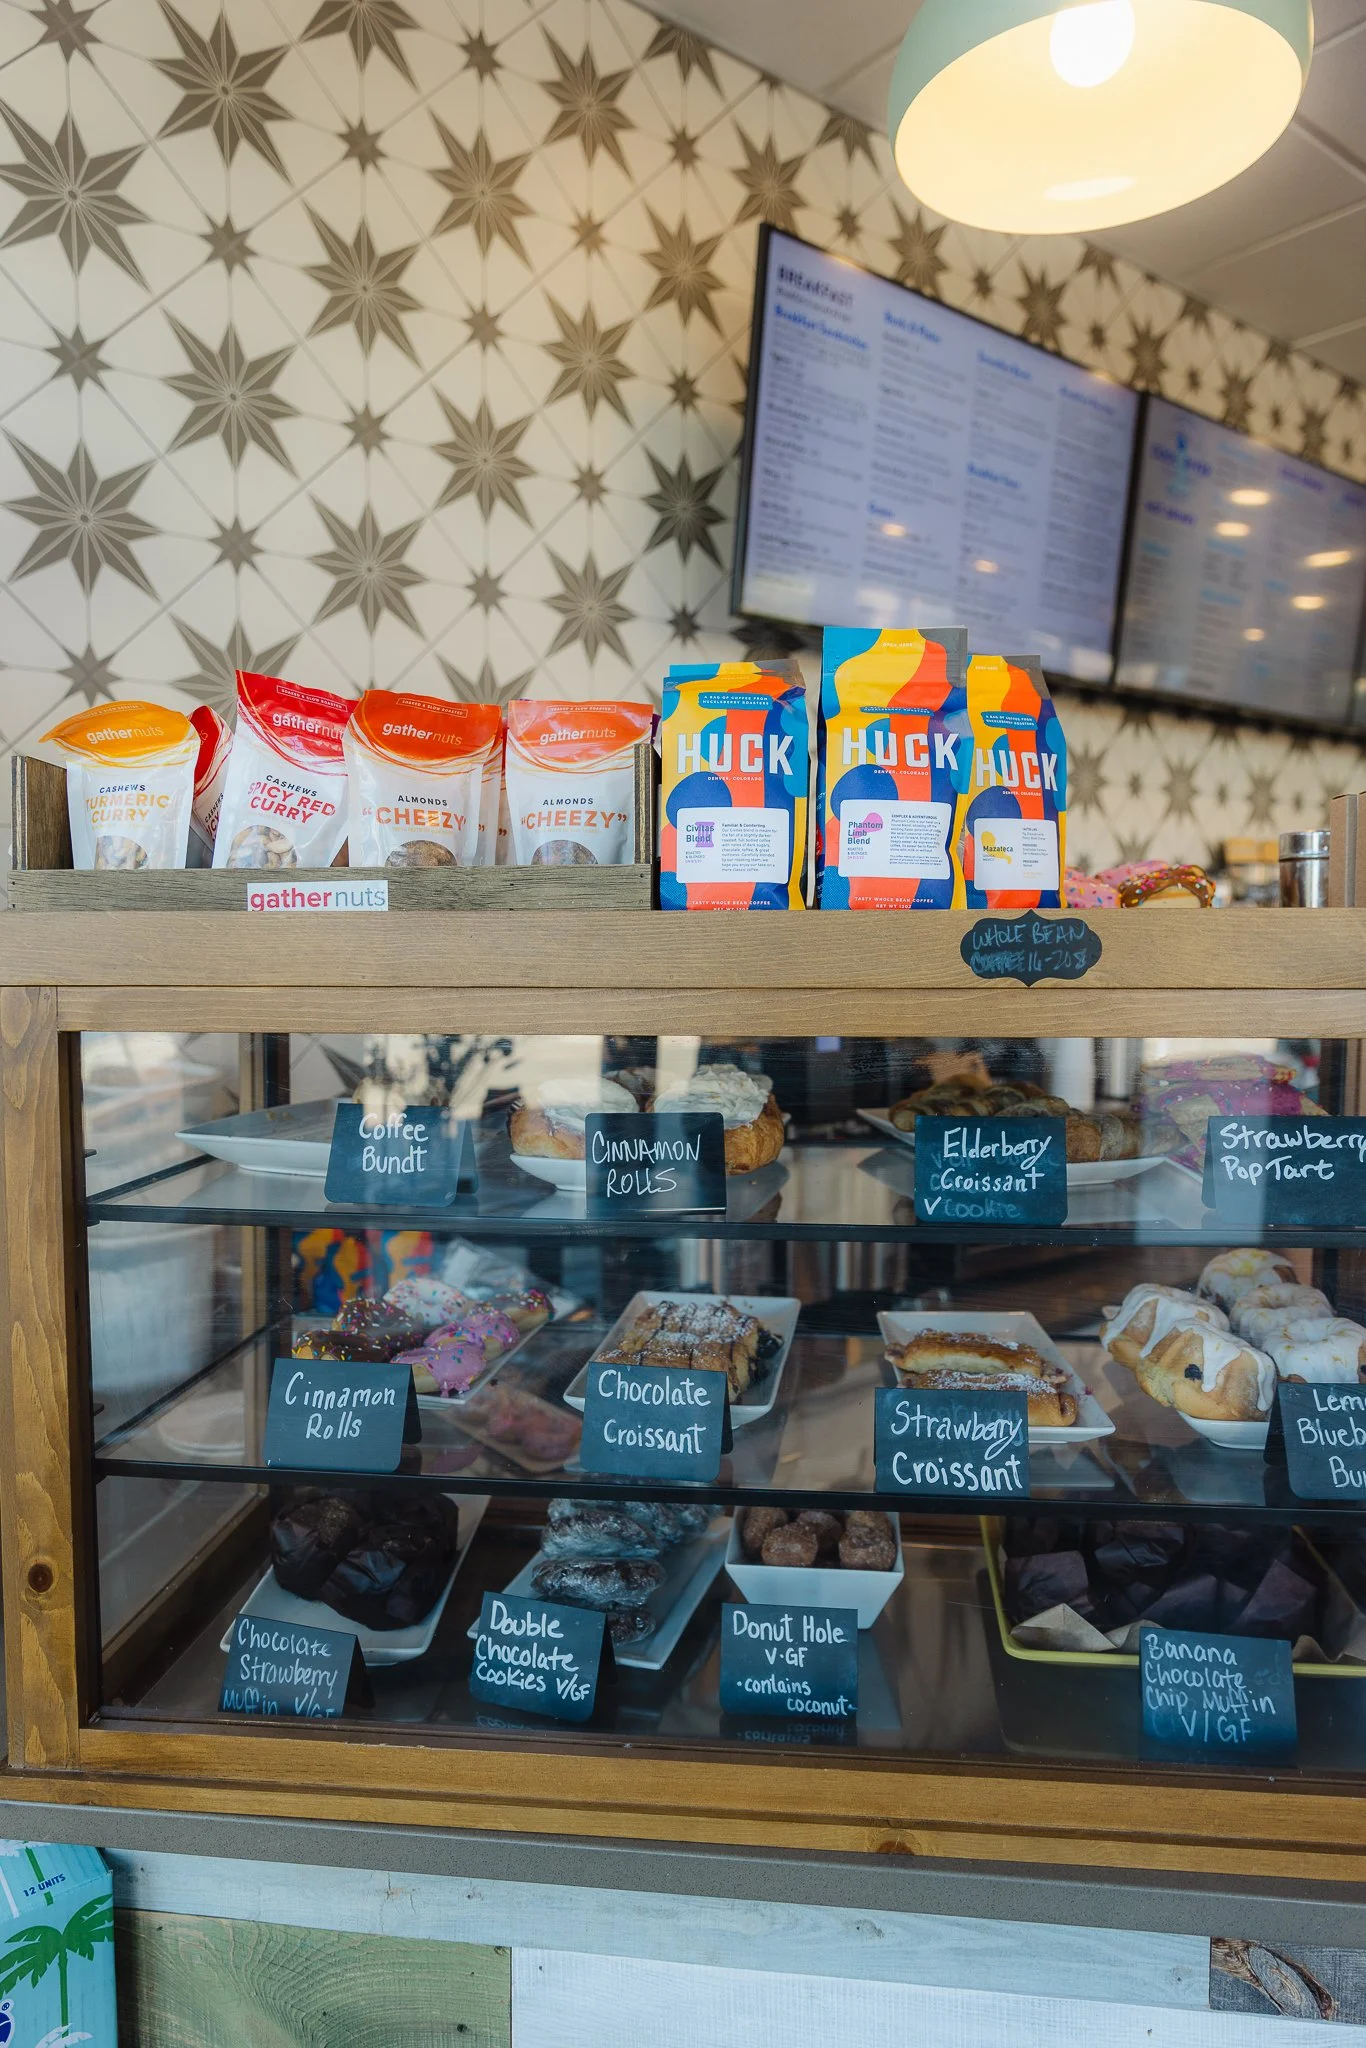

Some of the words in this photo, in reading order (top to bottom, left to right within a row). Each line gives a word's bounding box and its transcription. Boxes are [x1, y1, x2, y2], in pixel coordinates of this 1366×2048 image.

[677, 733, 794, 776] HUCK
[842, 727, 959, 771] HUCK
[975, 747, 1058, 792] HUCK
[99, 784, 146, 794] CASHEWS
[247, 781, 294, 802] SPICY
[297, 795, 336, 817] RED
[266, 774, 318, 797] CASHEWS
[91, 807, 150, 825] CURRY
[250, 796, 314, 824] CURRY
[398, 795, 448, 807] ALMONDS
[542, 797, 594, 806] ALMONDS
[685, 824, 715, 833] Civitas
[685, 834, 712, 843] Blend
[847, 829, 868, 837] Limb
[848, 821, 883, 829] Phantom
[847, 837, 871, 845] Blend
[982, 845, 1014, 853] Mazateca
[972, 923, 1027, 951] WHOLE
[1031, 921, 1086, 945] BEAN
[358, 1112, 429, 1142] Coffee
[592, 1130, 700, 1166] CINNAMON
[1219, 1122, 1366, 1163] Strawberry
[362, 1145, 428, 1174] Bundt
[606, 1168, 677, 1198] ROLLS
[940, 1166, 1045, 1192] Croissant
[284, 1371, 396, 1411] Cinnamon
[598, 1369, 711, 1408] Chocolate
[305, 1413, 362, 1440] Rolls
[603, 1418, 706, 1454] Croissant
[892, 1451, 1023, 1491] Croissant
[489, 1599, 564, 1639] Double
[733, 1610, 793, 1643] Donut
[802, 1615, 848, 1644] Hole
[237, 1618, 332, 1657] Chocolate
[1144, 1633, 1238, 1666] Banana
[475, 1634, 579, 1672] Chocolate
[240, 1653, 338, 1699] Strawberry
[475, 1661, 547, 1692] Cookies
[1144, 1661, 1247, 1689] Chocolate
[222, 1687, 278, 1715] Muffin
[1145, 1685, 1188, 1715] Chip
[1202, 1686, 1276, 1720] Muffin
[23, 1886, 37, 1897] 12
[37, 1873, 66, 1891] UNITS
